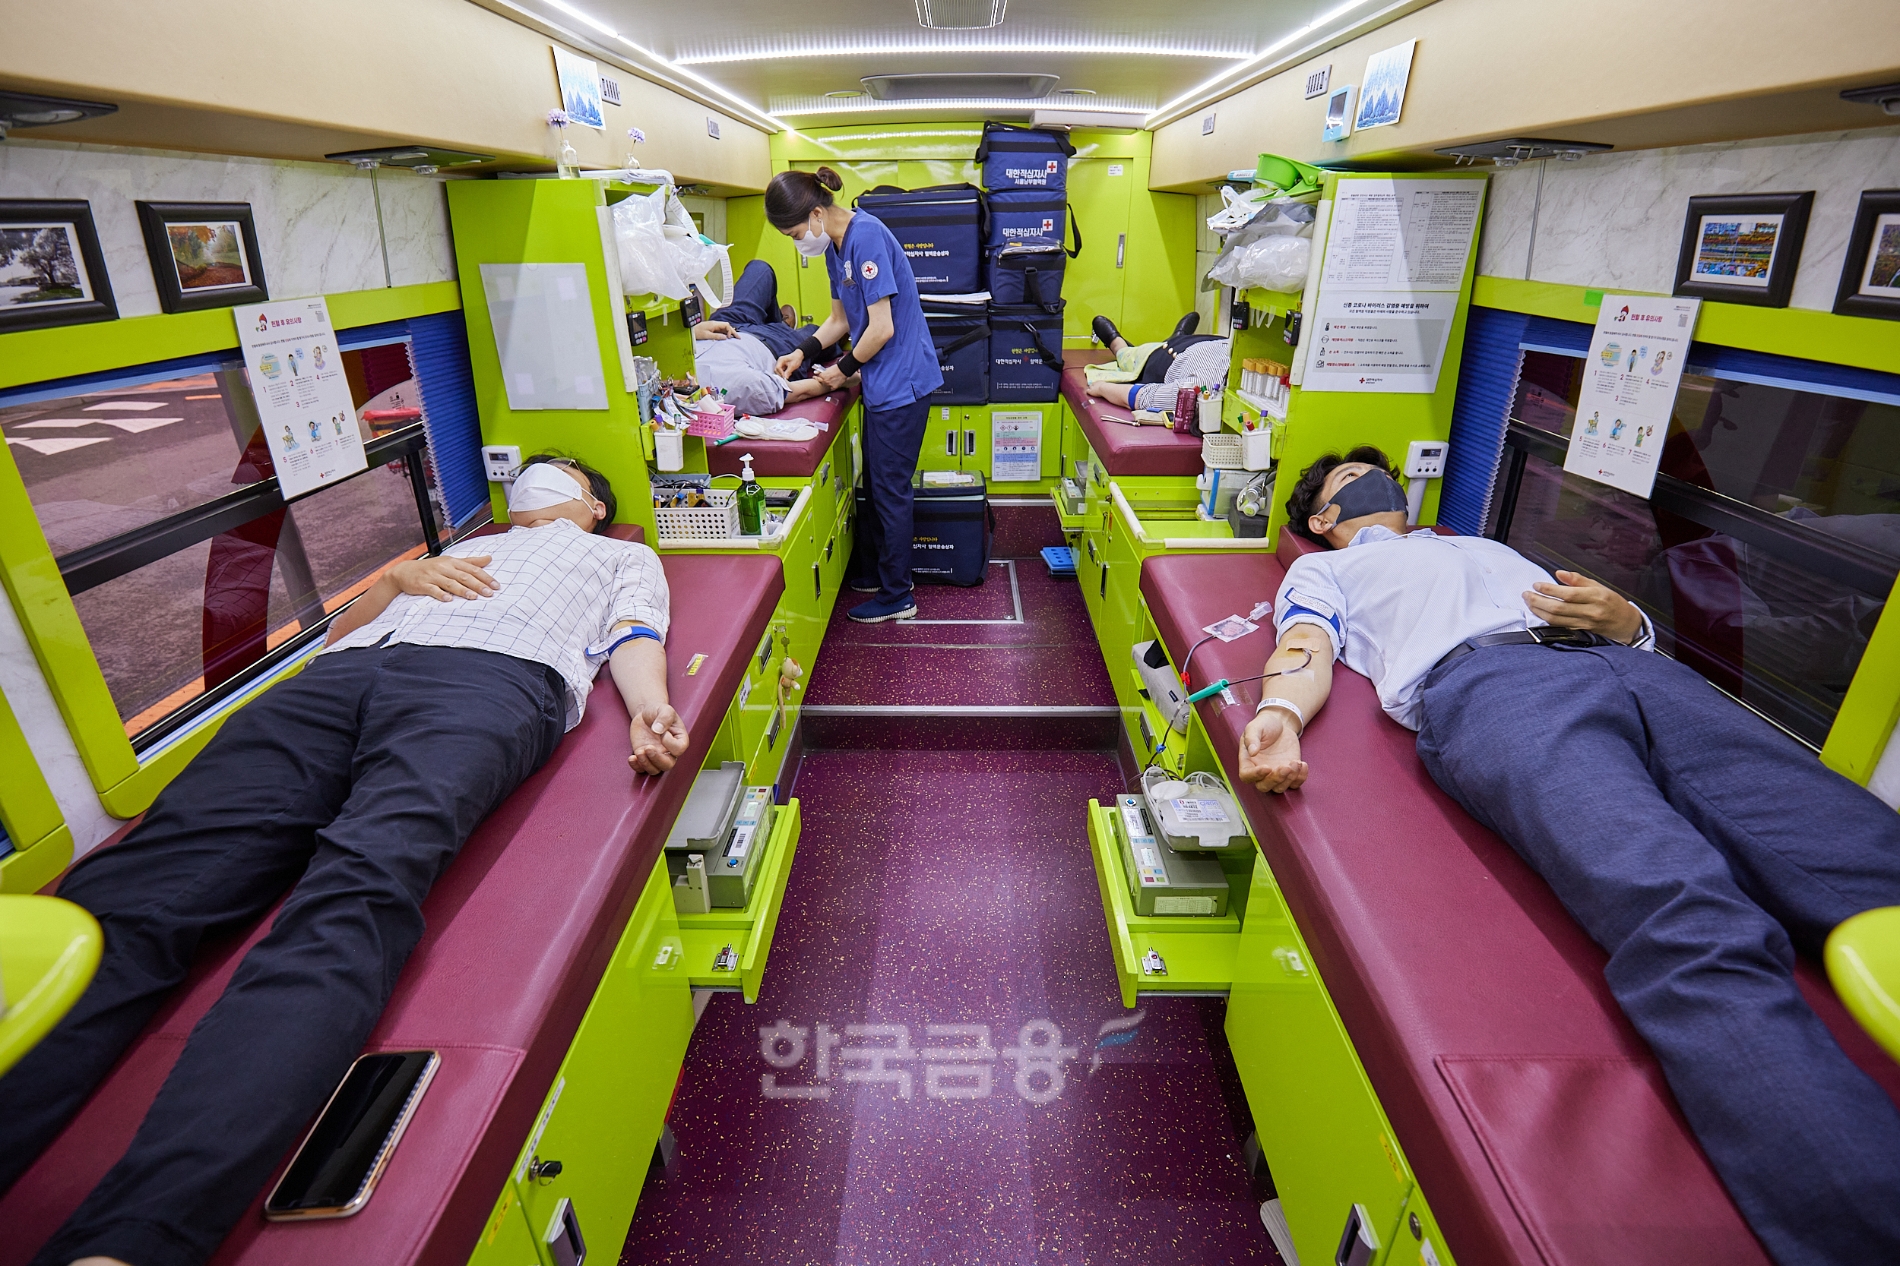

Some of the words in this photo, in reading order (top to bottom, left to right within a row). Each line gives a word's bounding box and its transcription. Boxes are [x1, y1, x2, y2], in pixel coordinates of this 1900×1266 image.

[1005, 168, 1047, 179] 대한적십자사
[1002, 227, 1043, 237] 대한적십자사
[286, 317, 302, 325] 유의사항
[1645, 314, 1663, 322] 유의사항
